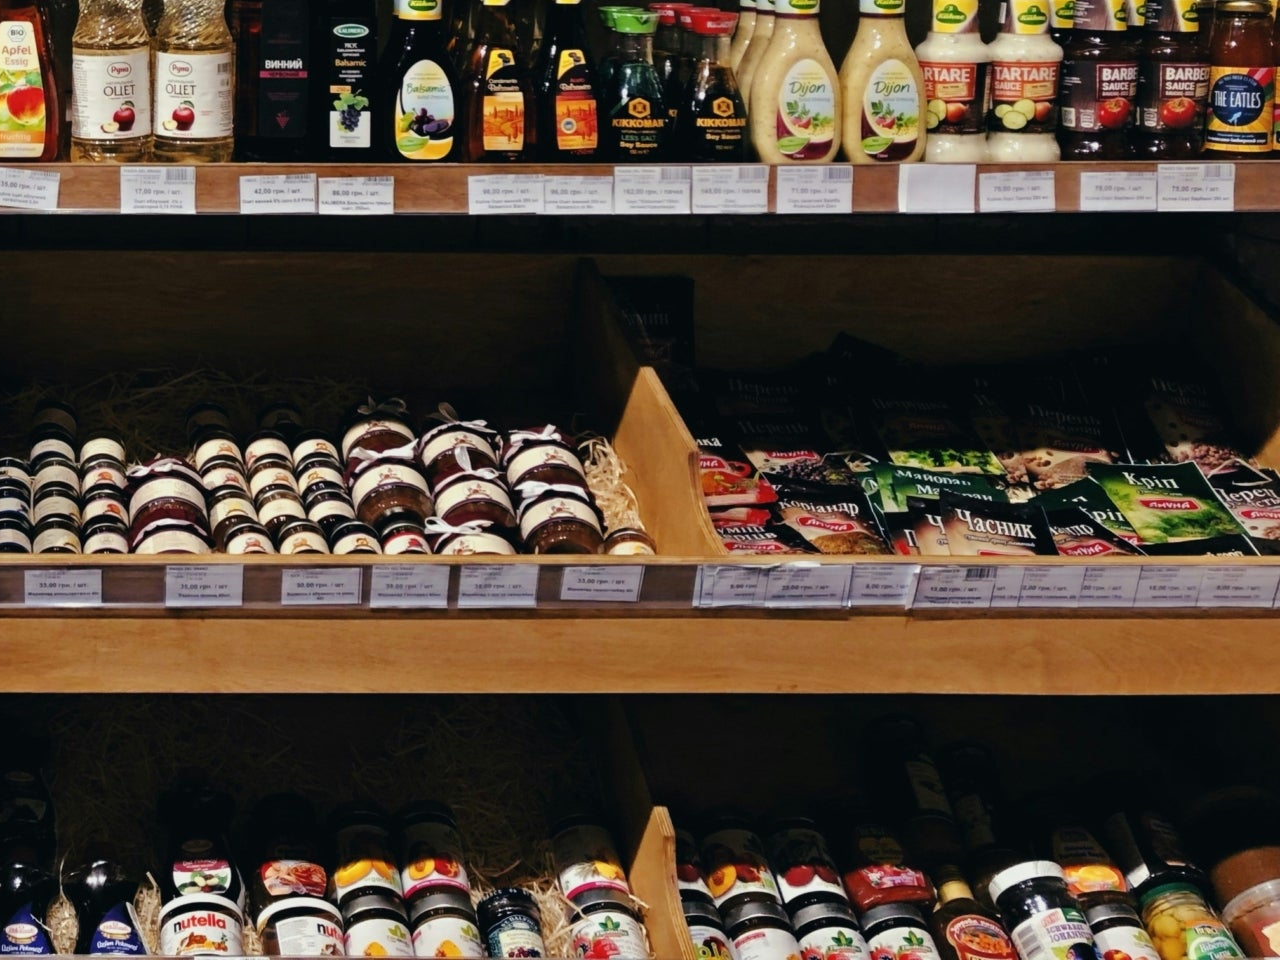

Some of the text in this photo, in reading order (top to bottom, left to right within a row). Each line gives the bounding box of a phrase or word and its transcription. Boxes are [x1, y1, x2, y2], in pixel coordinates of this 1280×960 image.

[1, 45, 31, 59] Apfel
[5, 57, 28, 67] Essig
[265, 58, 302, 69] ВИННИЙ
[335, 59, 367, 67] Balsamic
[922, 68, 970, 82] RTARE
[994, 67, 1056, 81] TARTARE
[103, 84, 135, 97] ОЦЕТ
[165, 83, 196, 96] ОЦЕТ
[790, 80, 826, 96] Dijon
[874, 81, 910, 96] Dijon
[994, 81, 1022, 91] SAUCE
[1102, 82, 1129, 90] SAUCE
[1166, 82, 1195, 90] SAUCE
[1215, 90, 1261, 108] THE EATLES
[1122, 472, 1180, 489] Кріп
[779, 498, 859, 517] Коріандр
[954, 508, 1037, 540] Часник
[173, 917, 227, 932] nutella
